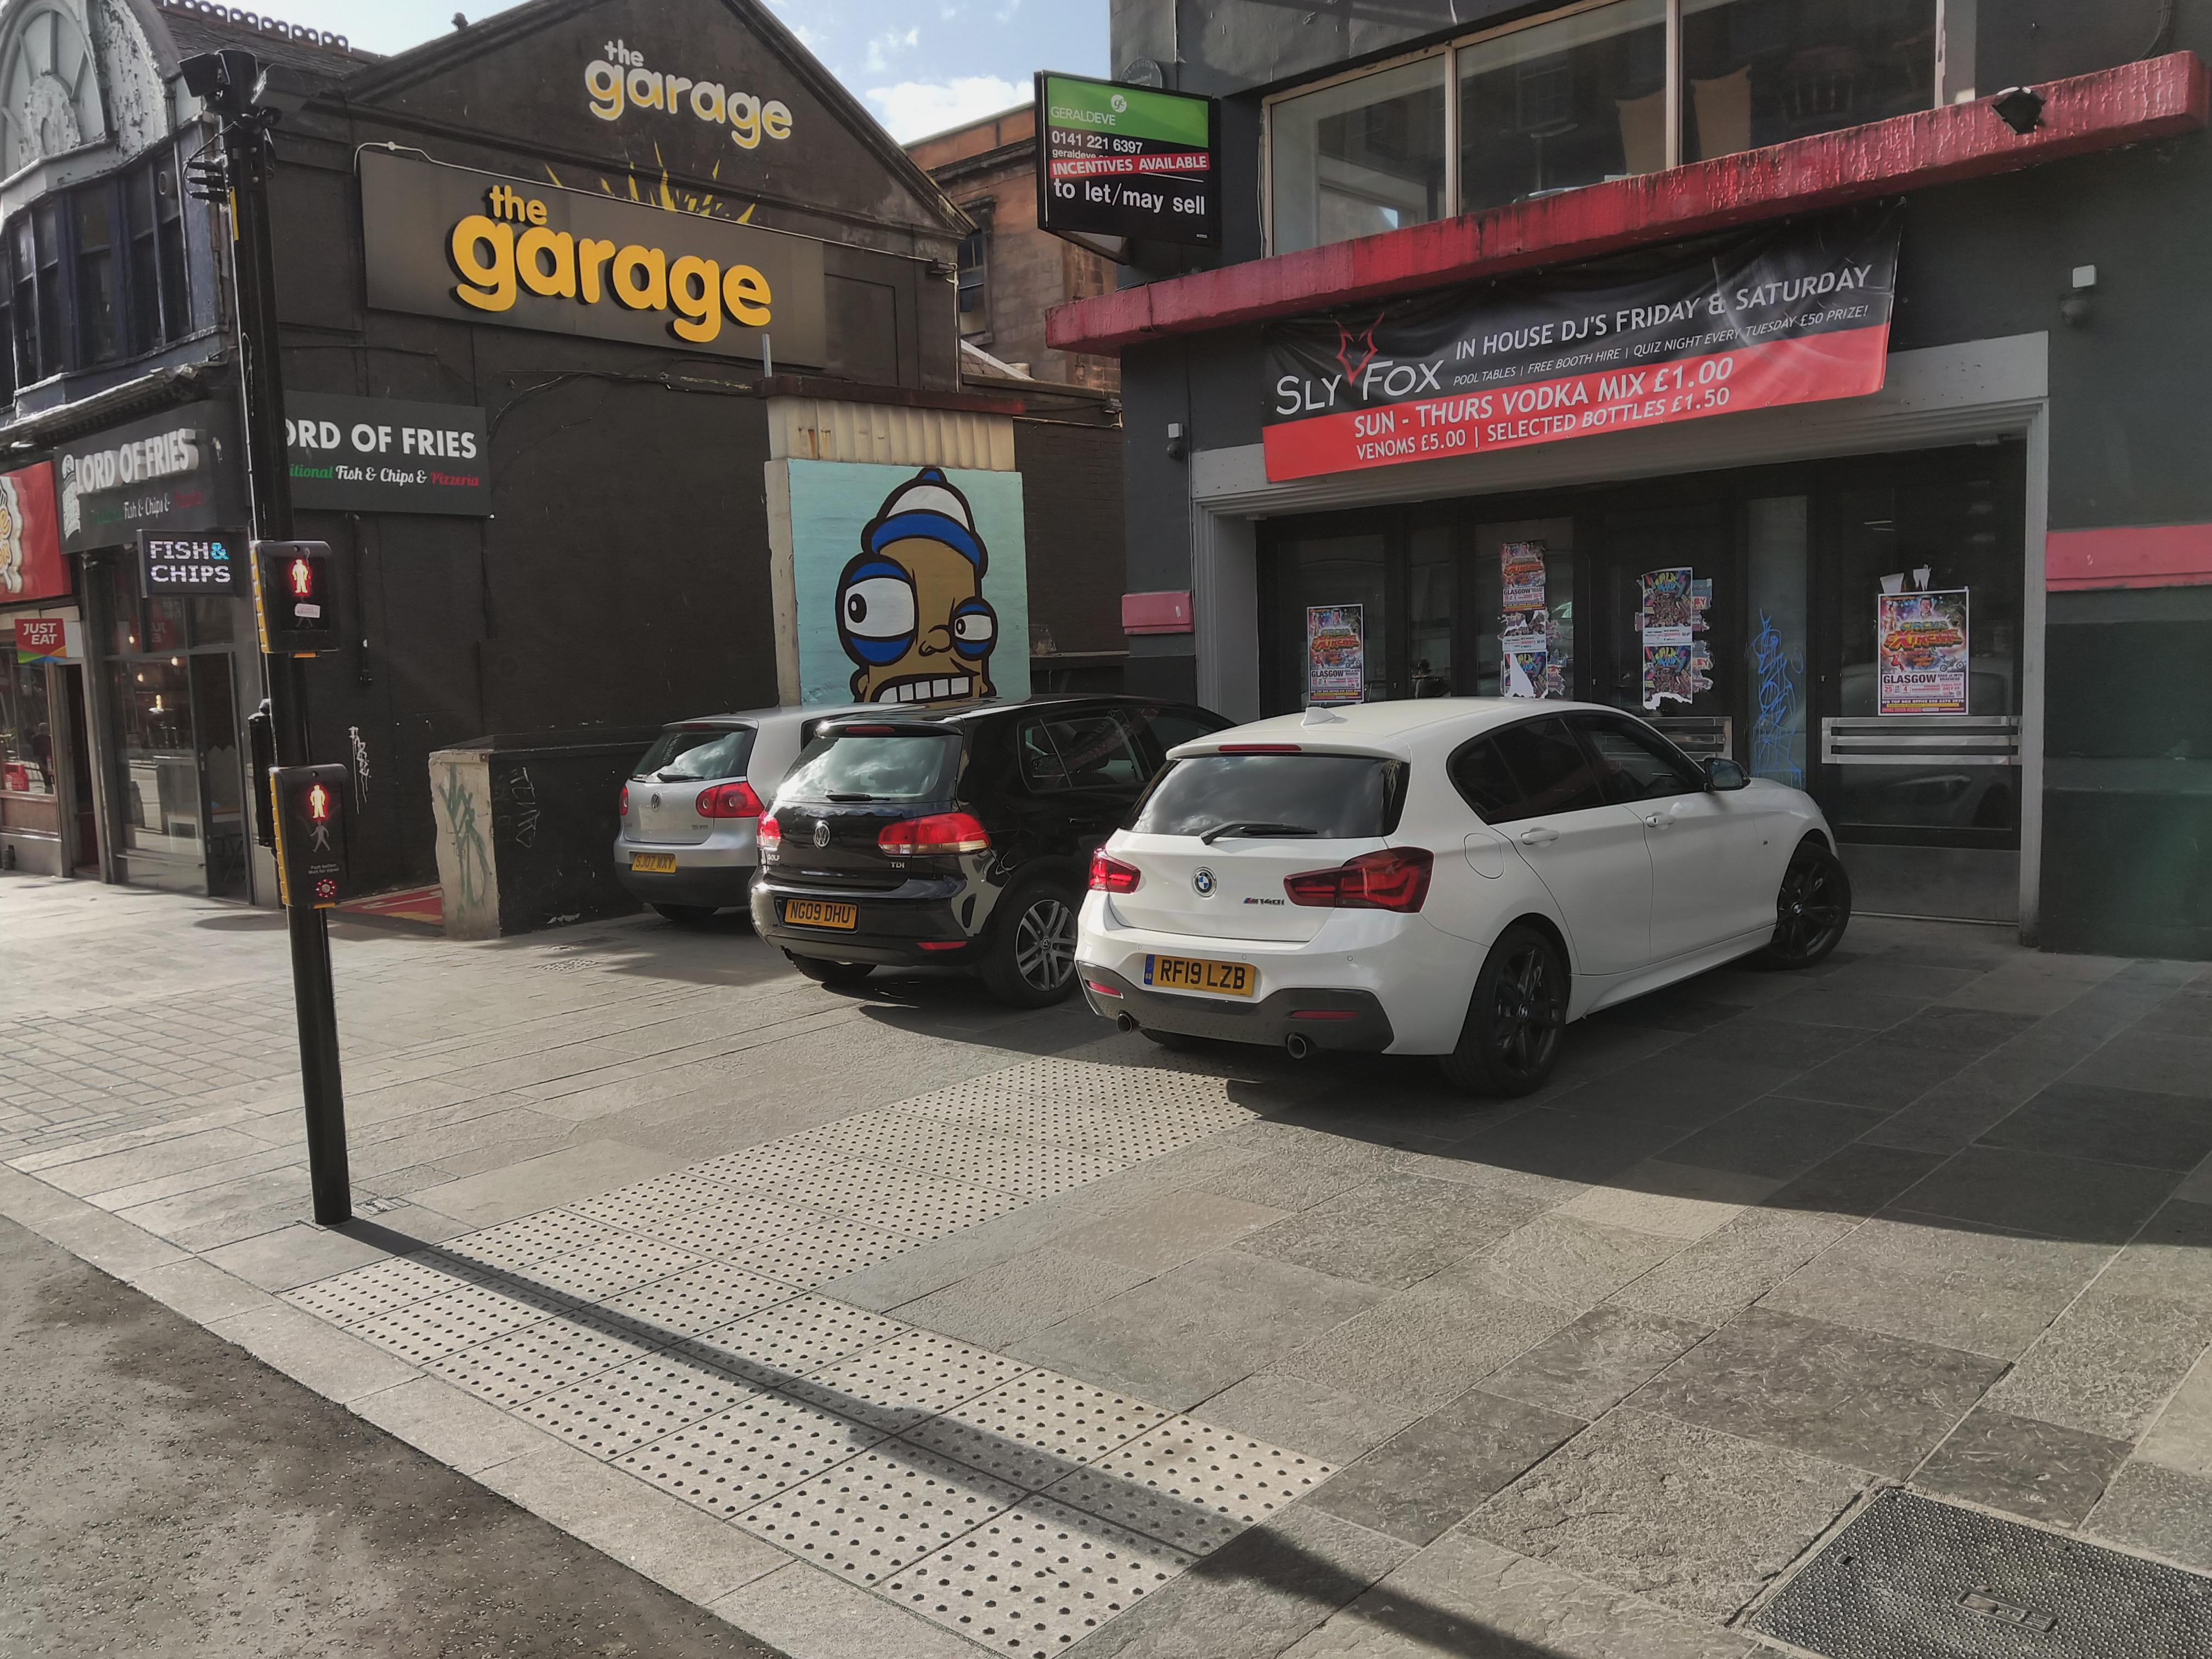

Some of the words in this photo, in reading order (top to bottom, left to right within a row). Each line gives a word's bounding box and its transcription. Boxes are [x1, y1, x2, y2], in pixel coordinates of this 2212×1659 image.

[604, 39, 644, 67] the
[585, 59, 793, 149] garage
[1050, 106, 1116, 126] GERALDEVE
[1052, 131, 1082, 146] 0141
[1087, 135, 1108, 150] 221
[1113, 139, 1143, 154] 6397
[1052, 159, 1133, 176] INCENTIVES
[1138, 156, 1207, 171] AVAILABLE
[489, 185, 548, 225] the
[1053, 178, 1076, 199] to
[1172, 195, 1205, 215] sell
[452, 214, 771, 342] garage
[1455, 338, 1476, 360] IN
[1483, 324, 1554, 356] HOUSE
[1561, 314, 1607, 341] DJ'S
[1615, 297, 1701, 332] FRIDAY
[1708, 292, 1726, 315] &
[1735, 264, 1872, 311] SATURDAY
[1453, 373, 1480, 387] POOL
[1481, 366, 1517, 382] TABLES
[1527, 358, 1555, 375] FREE
[1555, 352, 1594, 368] BOOTH
[1595, 348, 1622, 363] HIRE
[1633, 341, 1662, 357] QUIZ
[1663, 334, 1703, 352] NIGHT
[1703, 328, 1741, 345] EVERY
[1746, 315, 1798, 337] TUESDAY
[1799, 312, 1824, 329] £50
[1826, 303, 1868, 323] PRIZE!
[1276, 374, 1342, 415] SLY
[1362, 360, 1444, 401] FOX
[1354, 410, 1395, 438] SUN
[1414, 394, 1493, 428] THURS
[1501, 381, 1589, 415] VODKA
[1596, 371, 1648, 402] MIX
[1652, 356, 1734, 393] £1.00
[1356, 436, 1416, 461] VENOMS
[1420, 428, 1466, 452] £5.00
[1486, 413, 1576, 443] SELECTED
[1581, 397, 1666, 428] BOTTLES
[1671, 386, 1730, 414] £1.50
[351, 424, 392, 453] OF
[402, 427, 477, 459] FRIES
[75, 449, 122, 495] LORD
[119, 441, 148, 483] OF
[144, 428, 199, 479] FRIES
[335, 465, 363, 481] Fish
[365, 467, 377, 481] &
[380, 467, 414, 487] Chips
[416, 470, 427, 483] &
[123, 501, 137, 520] Fish
[150, 565, 231, 582] CHIPS
[23, 623, 57, 635] JUST
[31, 634, 57, 645] EAT
[1311, 669, 1344, 678] GLASGOW
[1883, 674, 1937, 684] GLASGOW
[790, 901, 821, 921] NG09
[824, 905, 851, 923] DHU
[1160, 959, 1201, 985] RF19
[1207, 964, 1245, 990] LZB
